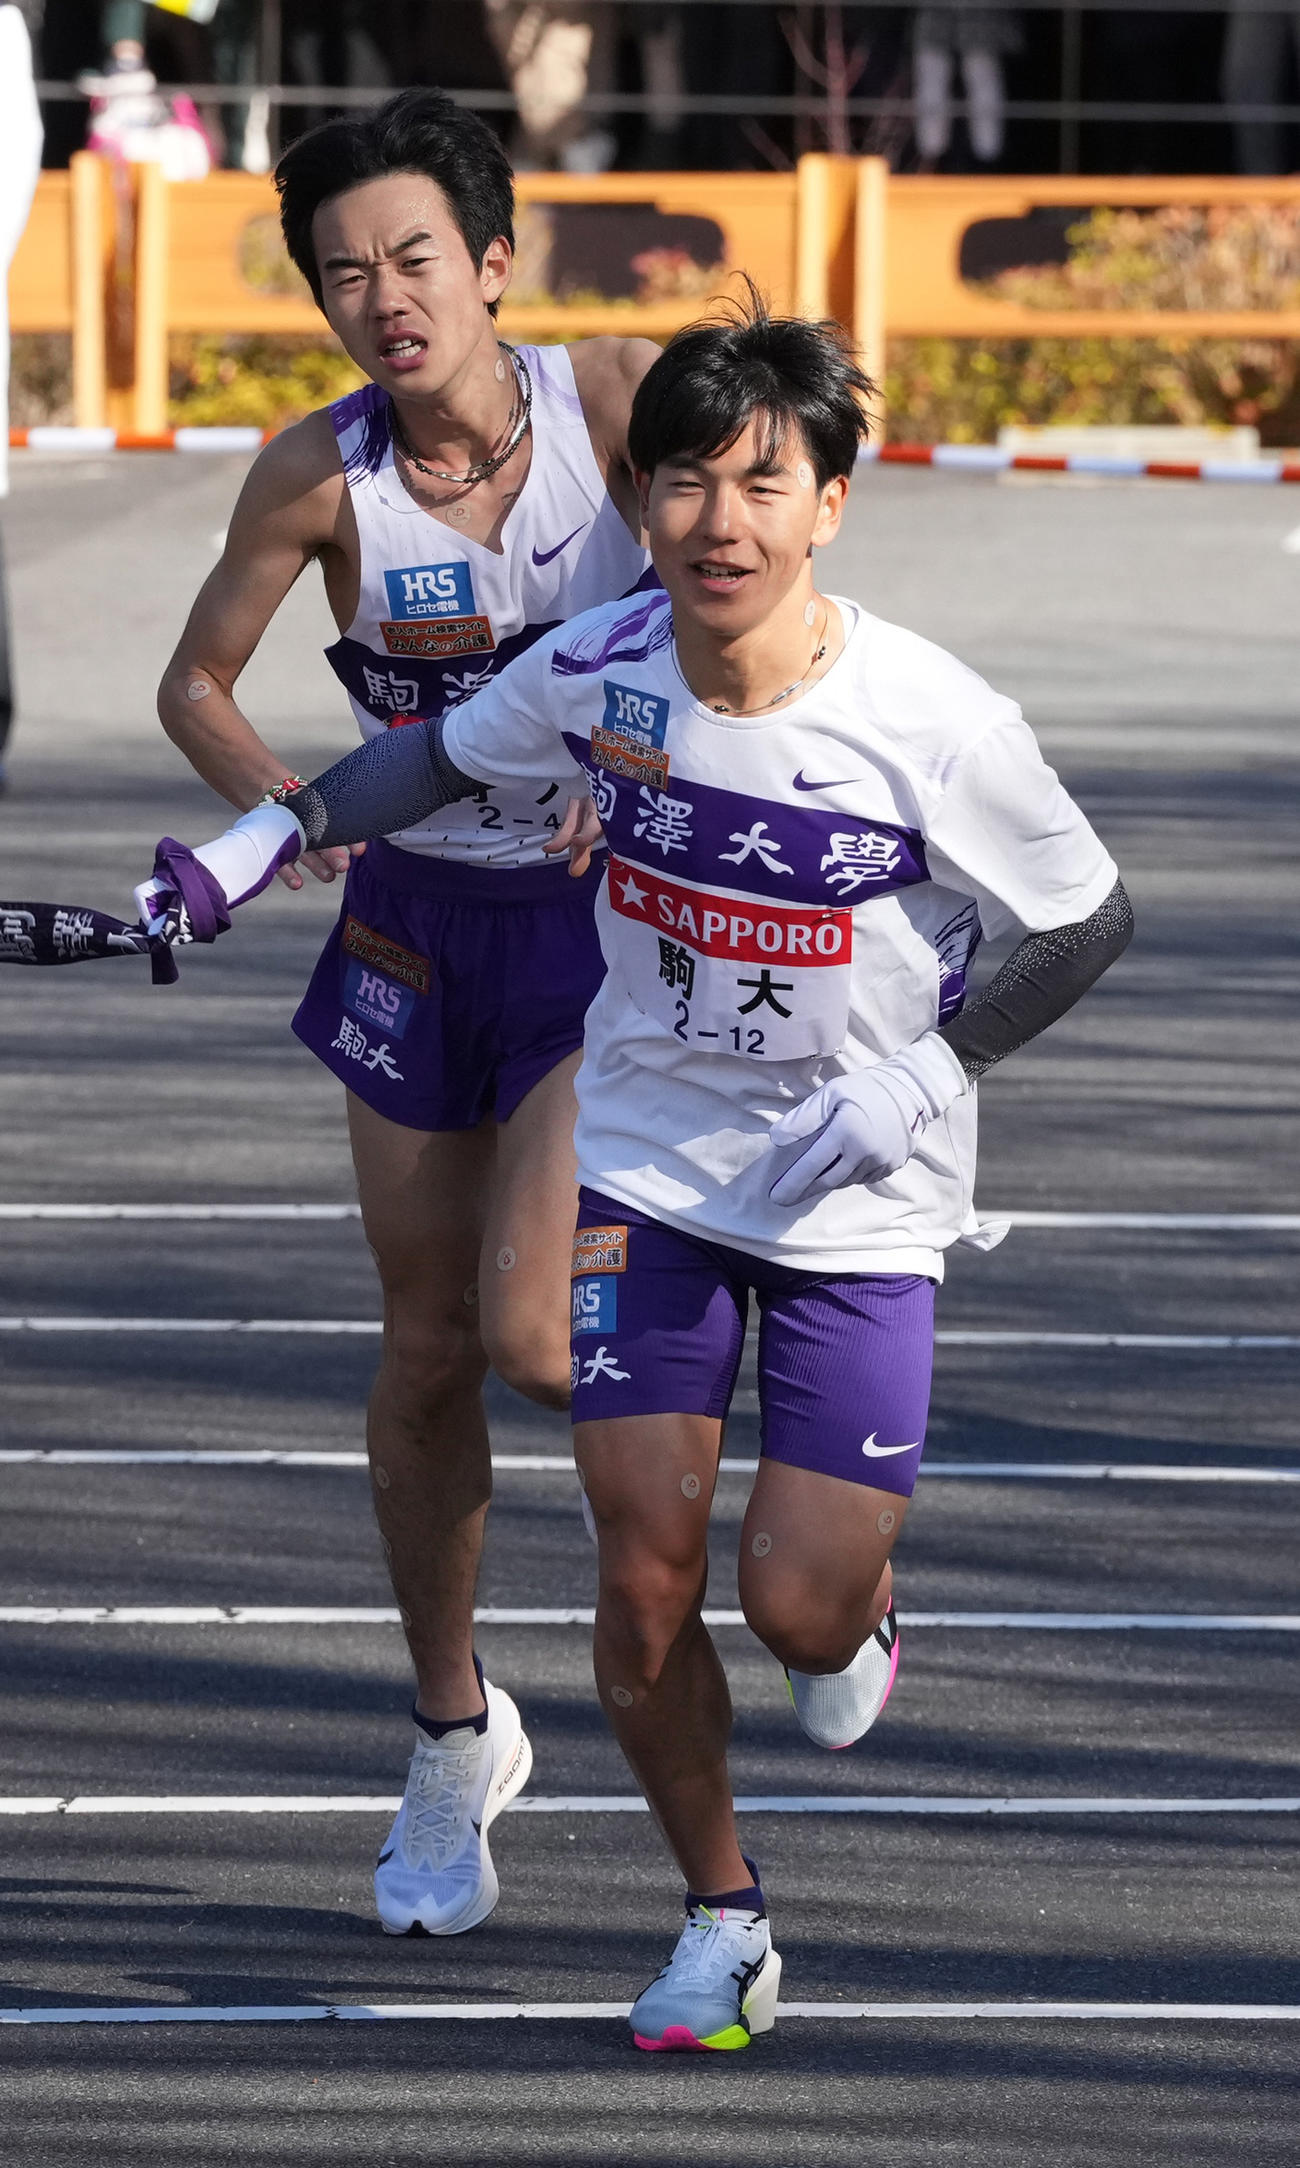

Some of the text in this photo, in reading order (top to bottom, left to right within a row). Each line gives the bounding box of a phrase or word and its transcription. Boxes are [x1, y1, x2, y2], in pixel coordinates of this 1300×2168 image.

[401, 568, 457, 602] HRS
[406, 600, 460, 615] ヒロセ電機
[386, 621, 486, 636] 老人ホーム検索サイト
[391, 634, 490, 653] みんなの介護
[615, 690, 658, 730] HRS
[593, 728, 667, 766] 老人ホーム検索サイト
[613, 720, 653, 747] ヒロセ電機
[592, 745, 664, 789] みんなの介護
[657, 893, 844, 956] SAPPORO
[357, 970, 403, 1014] HRS
[658, 936, 794, 1019] 駒大
[355, 997, 394, 1029] ヒロセ電機
[330, 1015, 405, 1081] 駒大
